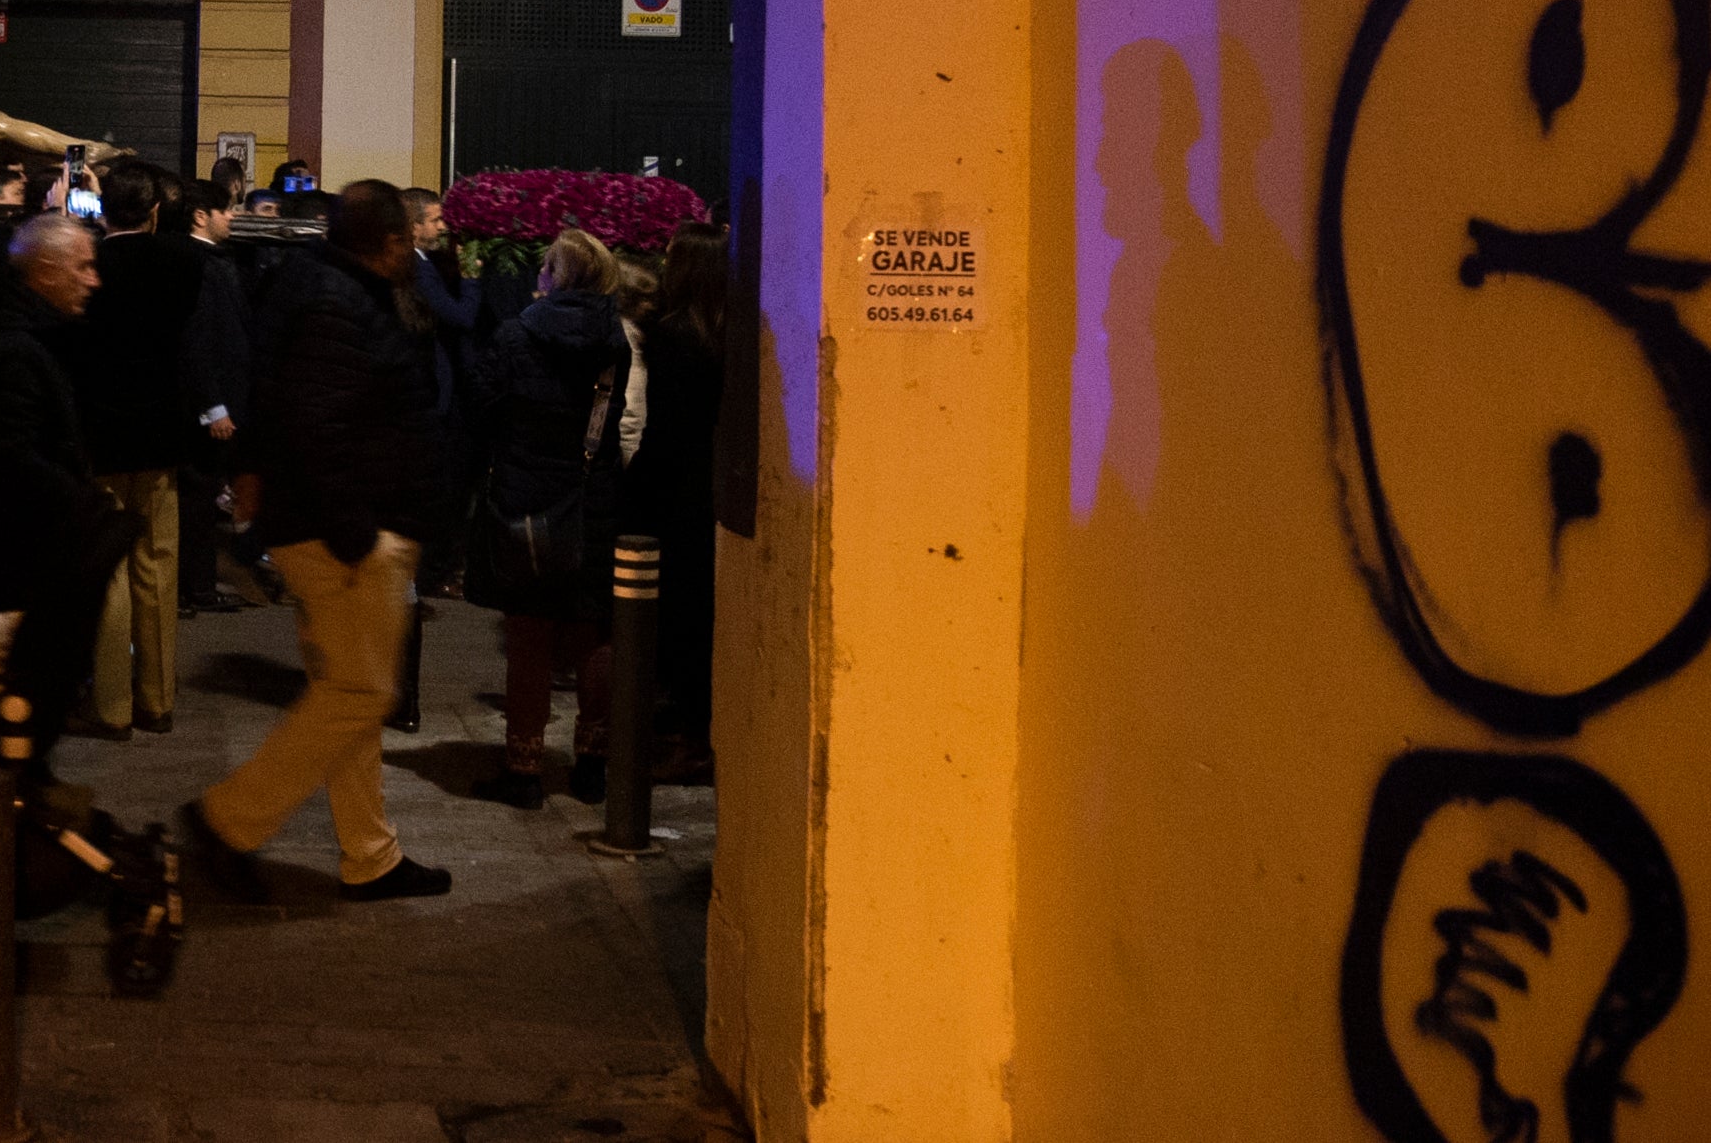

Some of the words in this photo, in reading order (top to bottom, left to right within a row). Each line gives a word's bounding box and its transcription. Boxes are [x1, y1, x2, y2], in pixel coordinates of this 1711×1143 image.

[640, 16, 663, 24] VADO
[874, 230, 897, 246] SE
[903, 230, 970, 247] VENDE
[872, 250, 975, 272] GARAJE
[867, 283, 934, 297] C/GOLES
[957, 285, 974, 296] 64
[867, 307, 973, 322] 605.49.61.64
